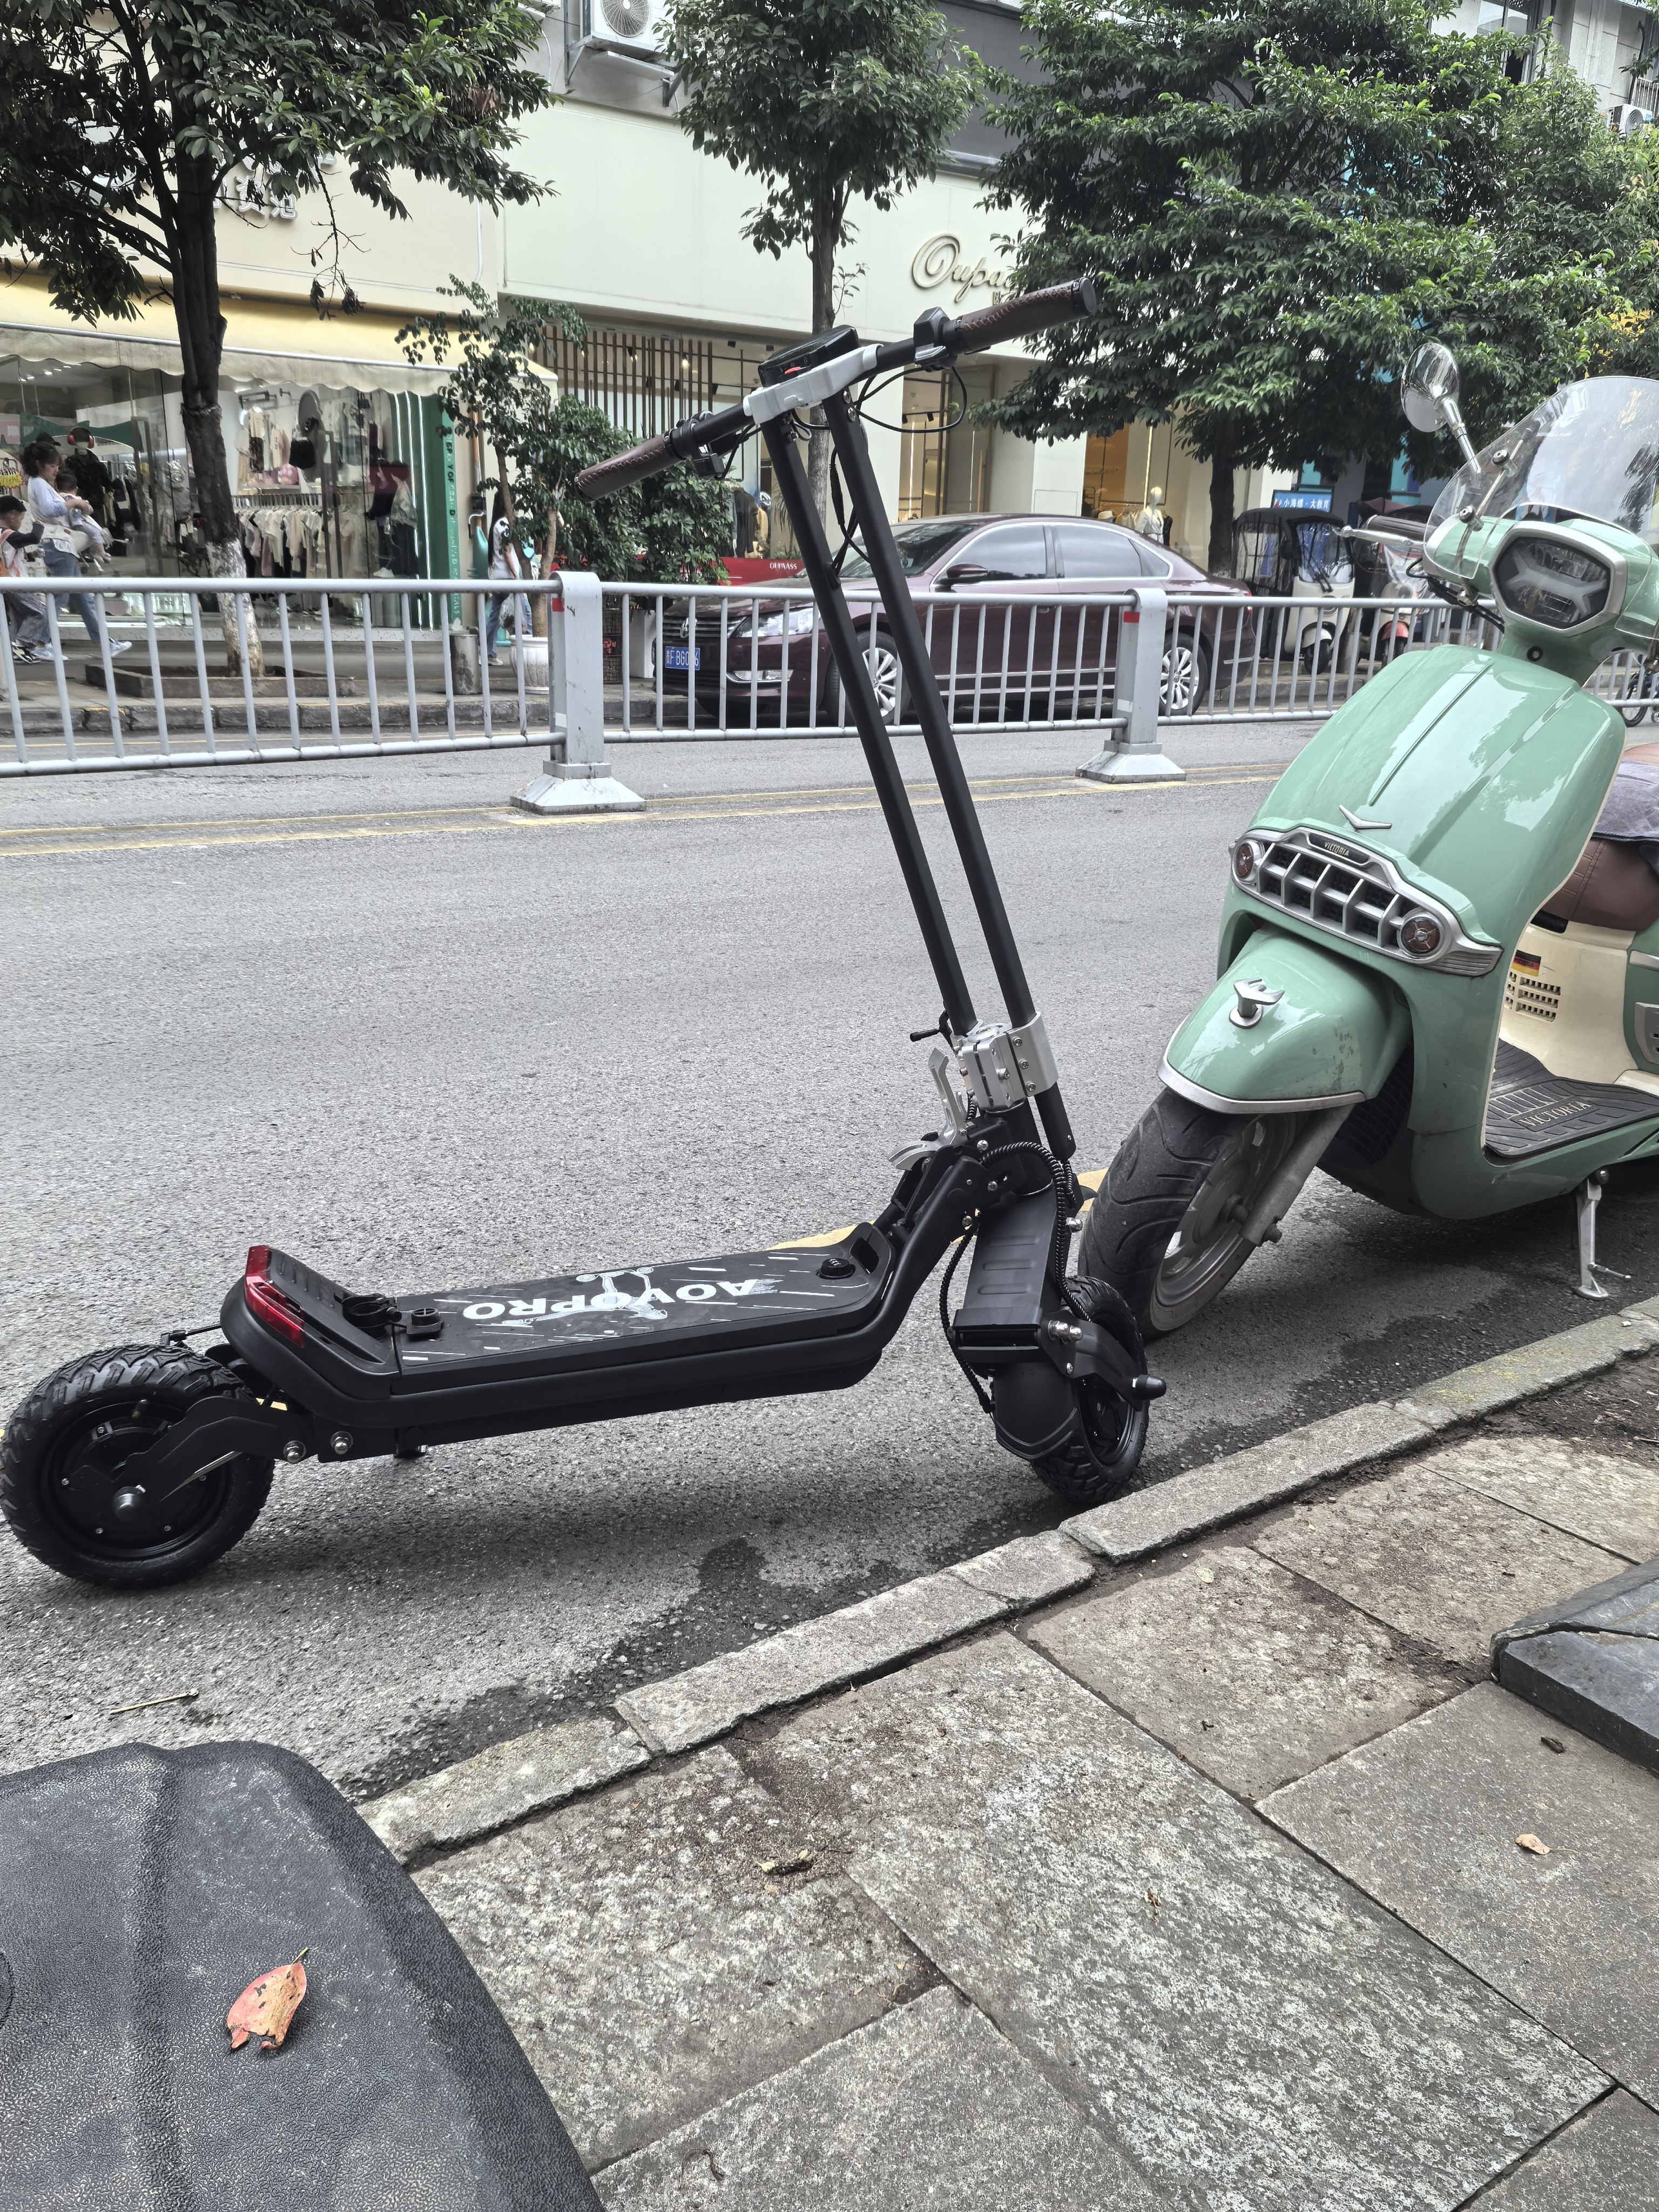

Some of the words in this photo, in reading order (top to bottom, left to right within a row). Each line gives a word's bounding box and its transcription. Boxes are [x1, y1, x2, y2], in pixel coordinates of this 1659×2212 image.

[912, 233, 1013, 303] Oupa
[1325, 842, 1349, 855] VICTORIA
[1519, 1101, 1592, 1126] VICTORIA
[463, 1279, 757, 1319] AOVOPRO
